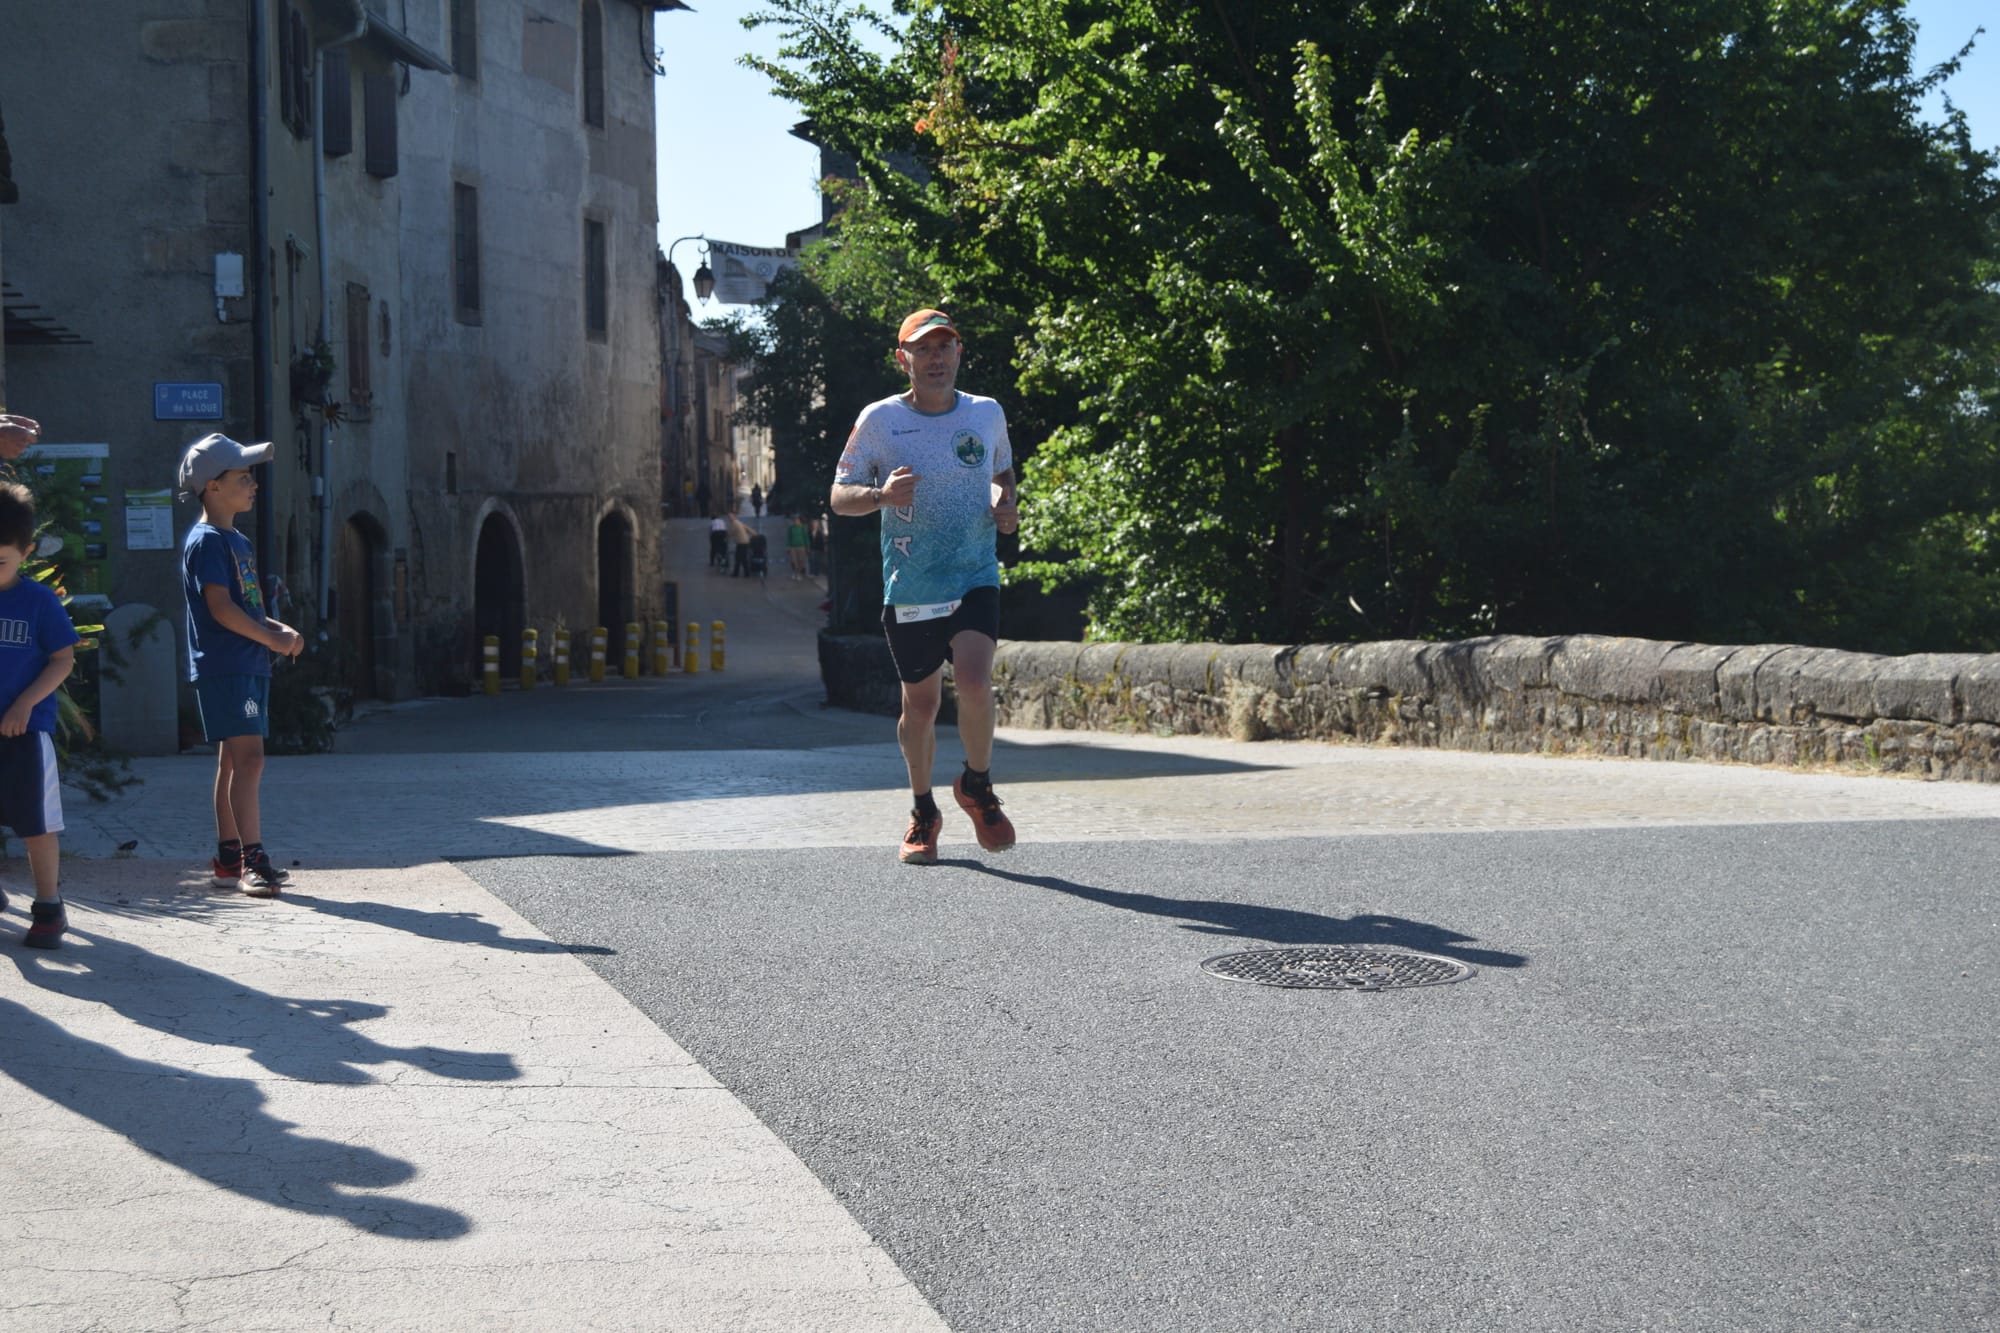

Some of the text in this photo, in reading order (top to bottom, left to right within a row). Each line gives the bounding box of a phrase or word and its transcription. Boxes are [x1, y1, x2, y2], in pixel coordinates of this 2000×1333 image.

[712, 243, 772, 256] MAISON
[182, 389, 208, 400] PLACE
[195, 402, 217, 413] LOUE
